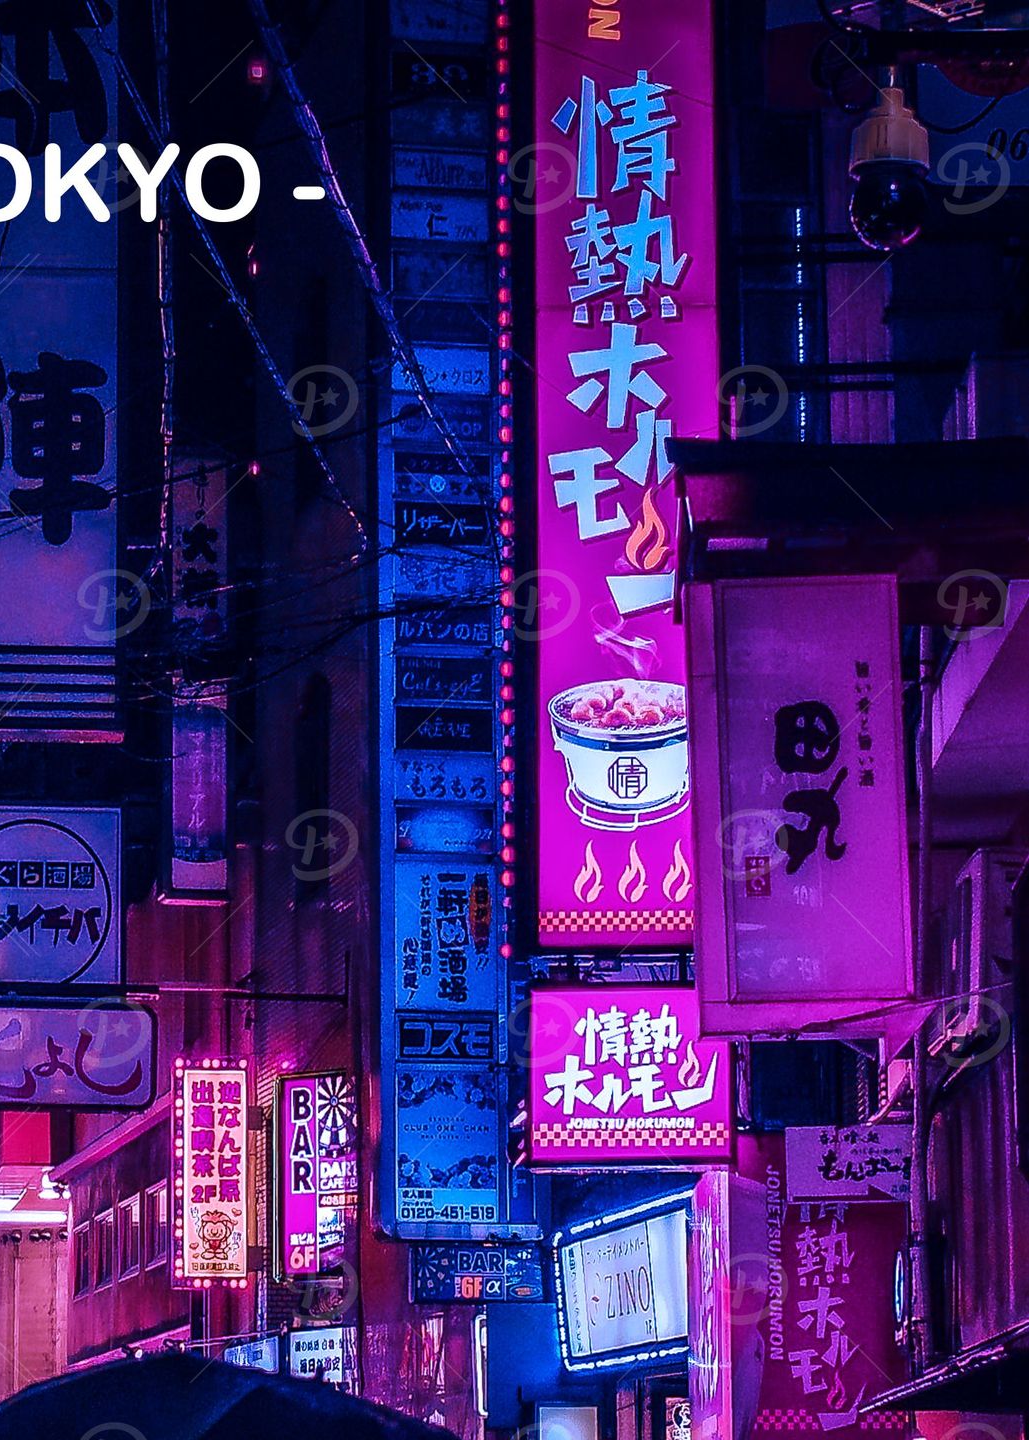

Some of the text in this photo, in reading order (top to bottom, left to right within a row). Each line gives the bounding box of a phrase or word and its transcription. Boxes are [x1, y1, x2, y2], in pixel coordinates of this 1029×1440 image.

[588, 0, 620, 40] N
[402, 1021, 491, 1057] コスモ
[574, 1003, 683, 1067] 情熱
[543, 1050, 718, 1116] ホルモン
[290, 1087, 315, 1195] BAR
[190, 1184, 218, 1204] 2F
[290, 1245, 315, 1270] 6F
[457, 1251, 504, 1274] BAR
[765, 1164, 784, 1361] JONETSU HORUMON
[461, 1276, 483, 1299] 6F
[605, 1265, 651, 1320] ZINO
